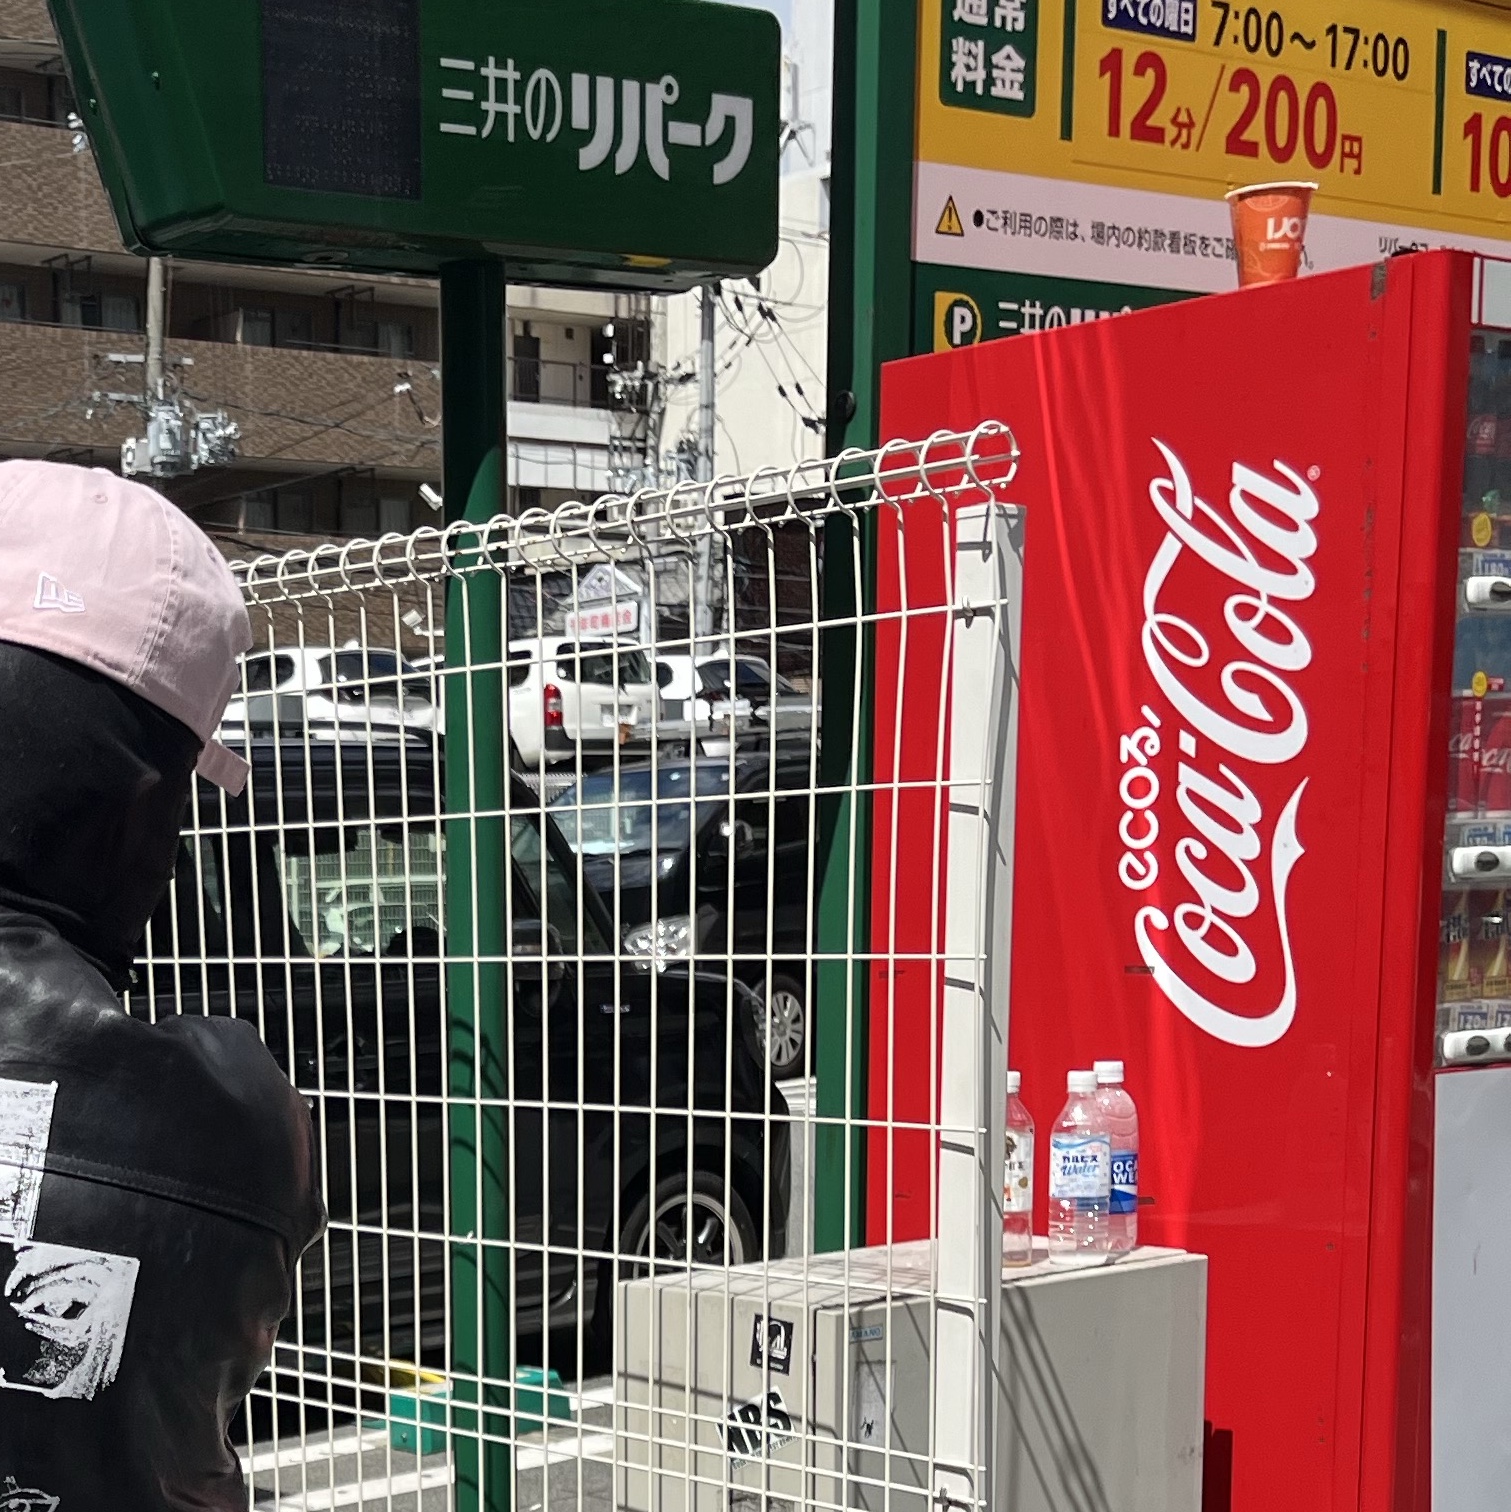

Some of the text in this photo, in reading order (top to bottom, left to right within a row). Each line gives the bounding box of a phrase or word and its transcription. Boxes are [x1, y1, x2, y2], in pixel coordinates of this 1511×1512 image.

[439, 56, 754, 186] 三井のリパーク
[951, 36, 1026, 101] 料金
[1133, 437, 1320, 1048] Coca-Cola
